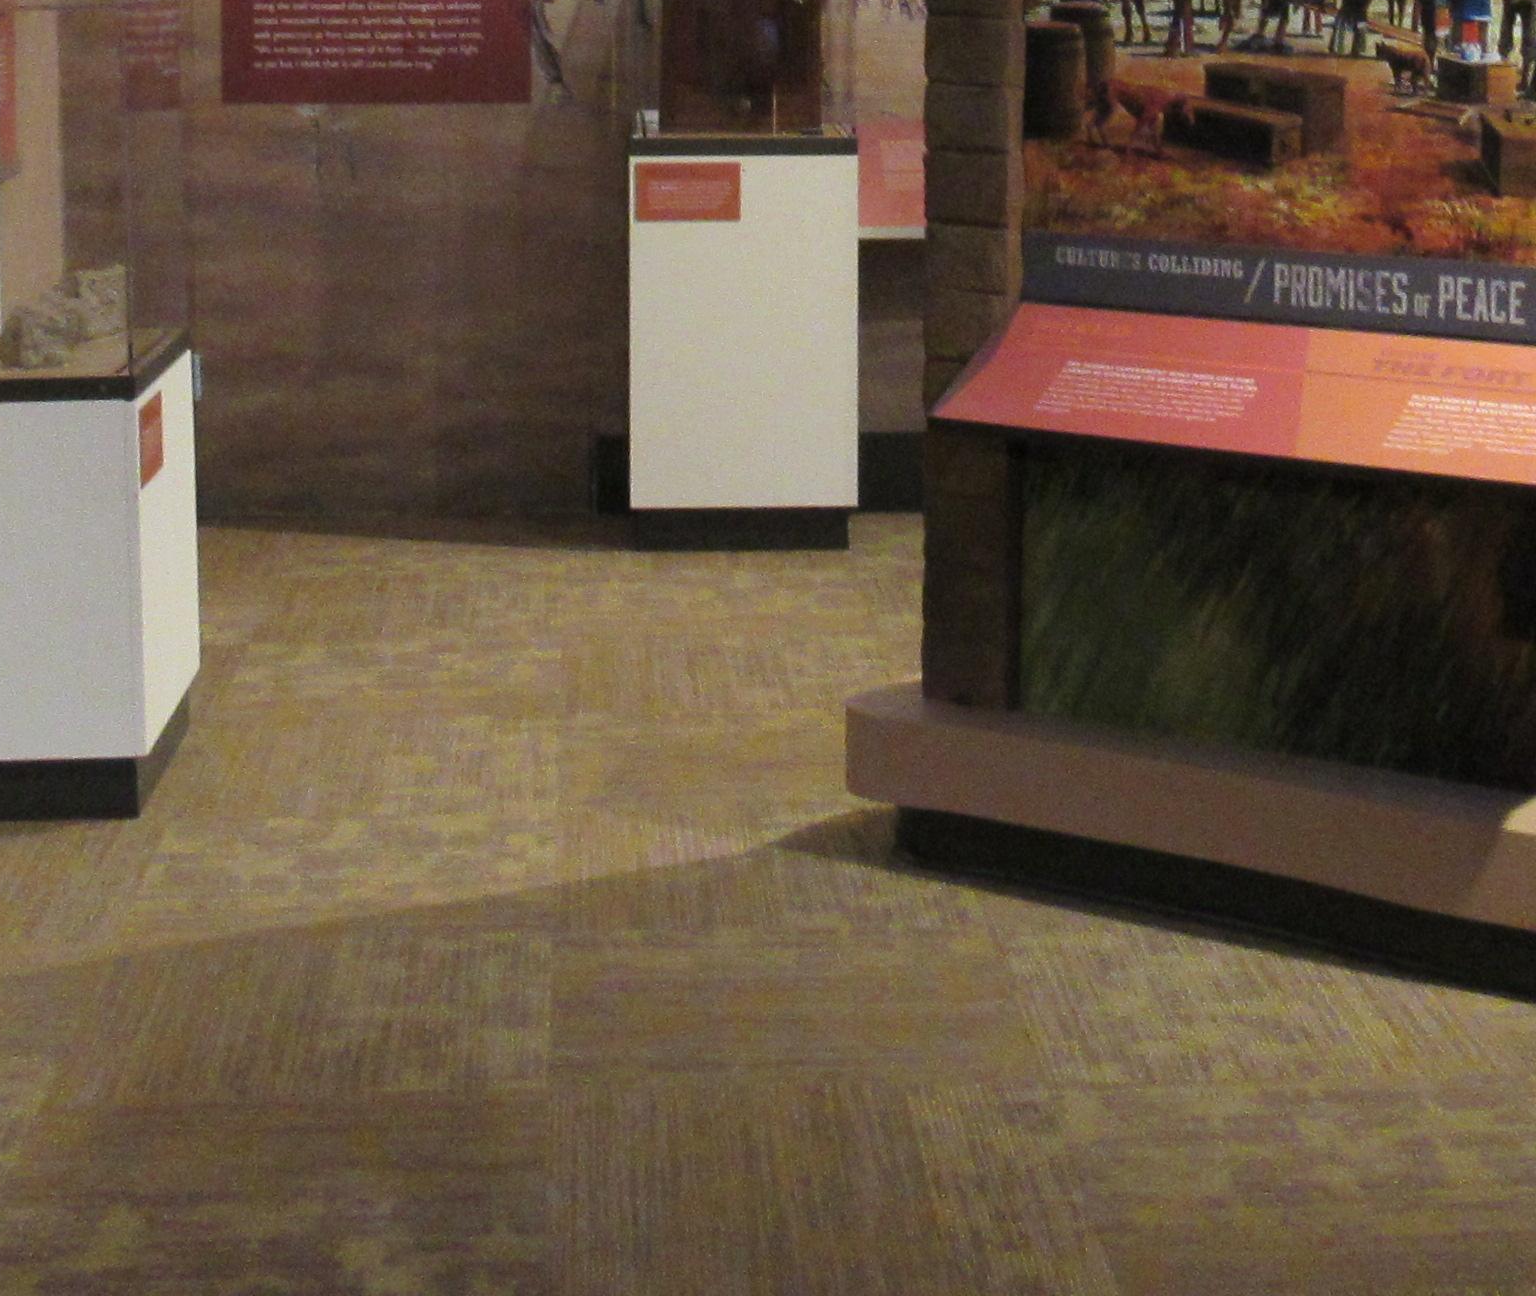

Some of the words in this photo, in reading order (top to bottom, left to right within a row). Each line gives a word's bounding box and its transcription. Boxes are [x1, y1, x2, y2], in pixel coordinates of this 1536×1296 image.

[1055, 245, 1142, 271] CULTURS
[1147, 254, 1244, 281] COLLIDING
[1273, 262, 1409, 318] PROMISES
[1438, 274, 1528, 327] PEACE
